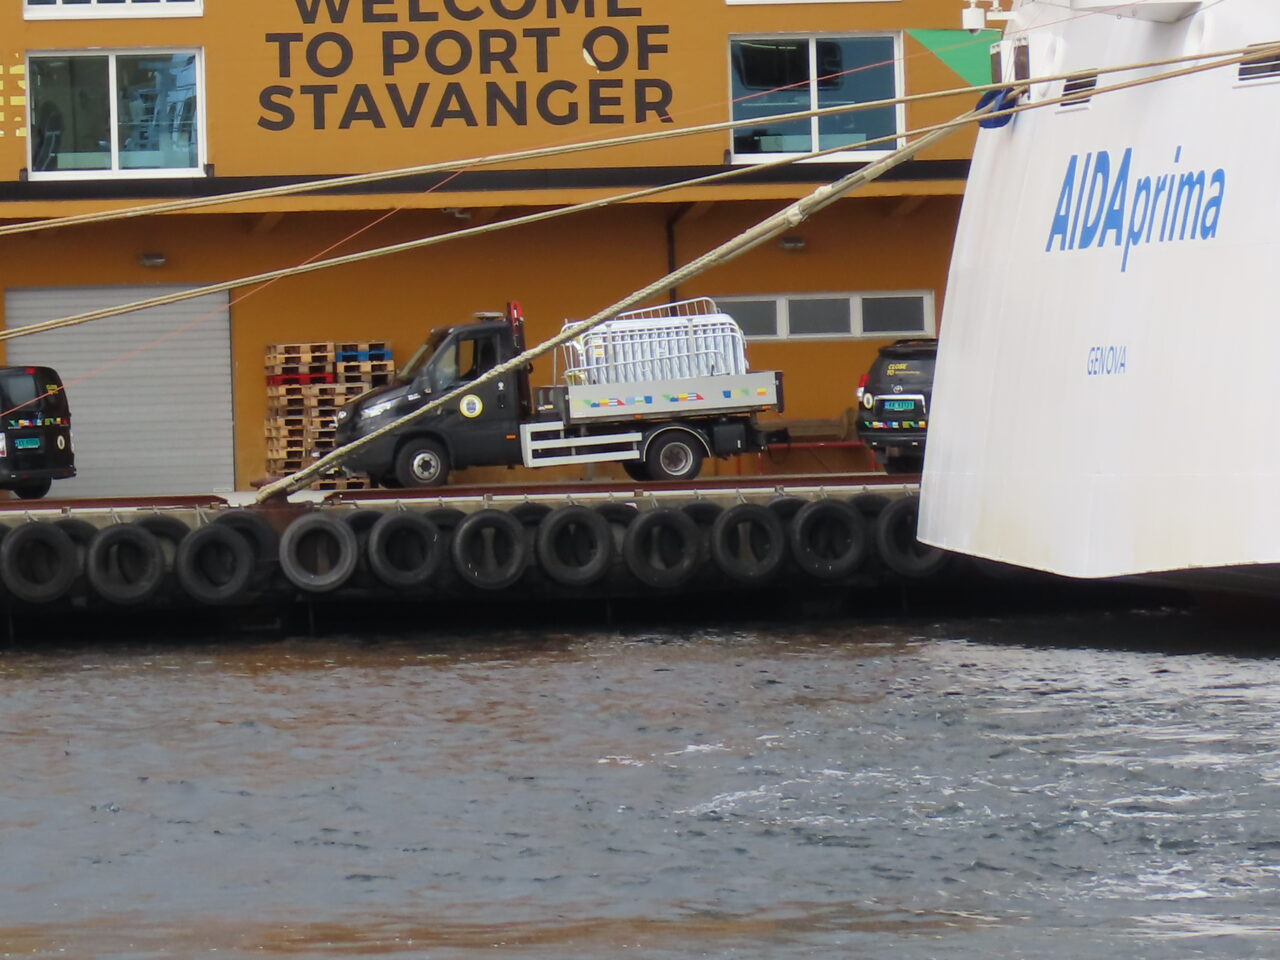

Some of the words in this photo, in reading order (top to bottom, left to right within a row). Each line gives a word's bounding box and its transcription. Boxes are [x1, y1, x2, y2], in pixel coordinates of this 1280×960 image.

[265, 31, 353, 78] TO
[382, 27, 560, 76] PORT
[582, 24, 669, 72] OF
[257, 78, 674, 131] STAVANGER
[1045, 145, 1226, 272] AIDAprima
[1087, 345, 1127, 375] GENOVA
